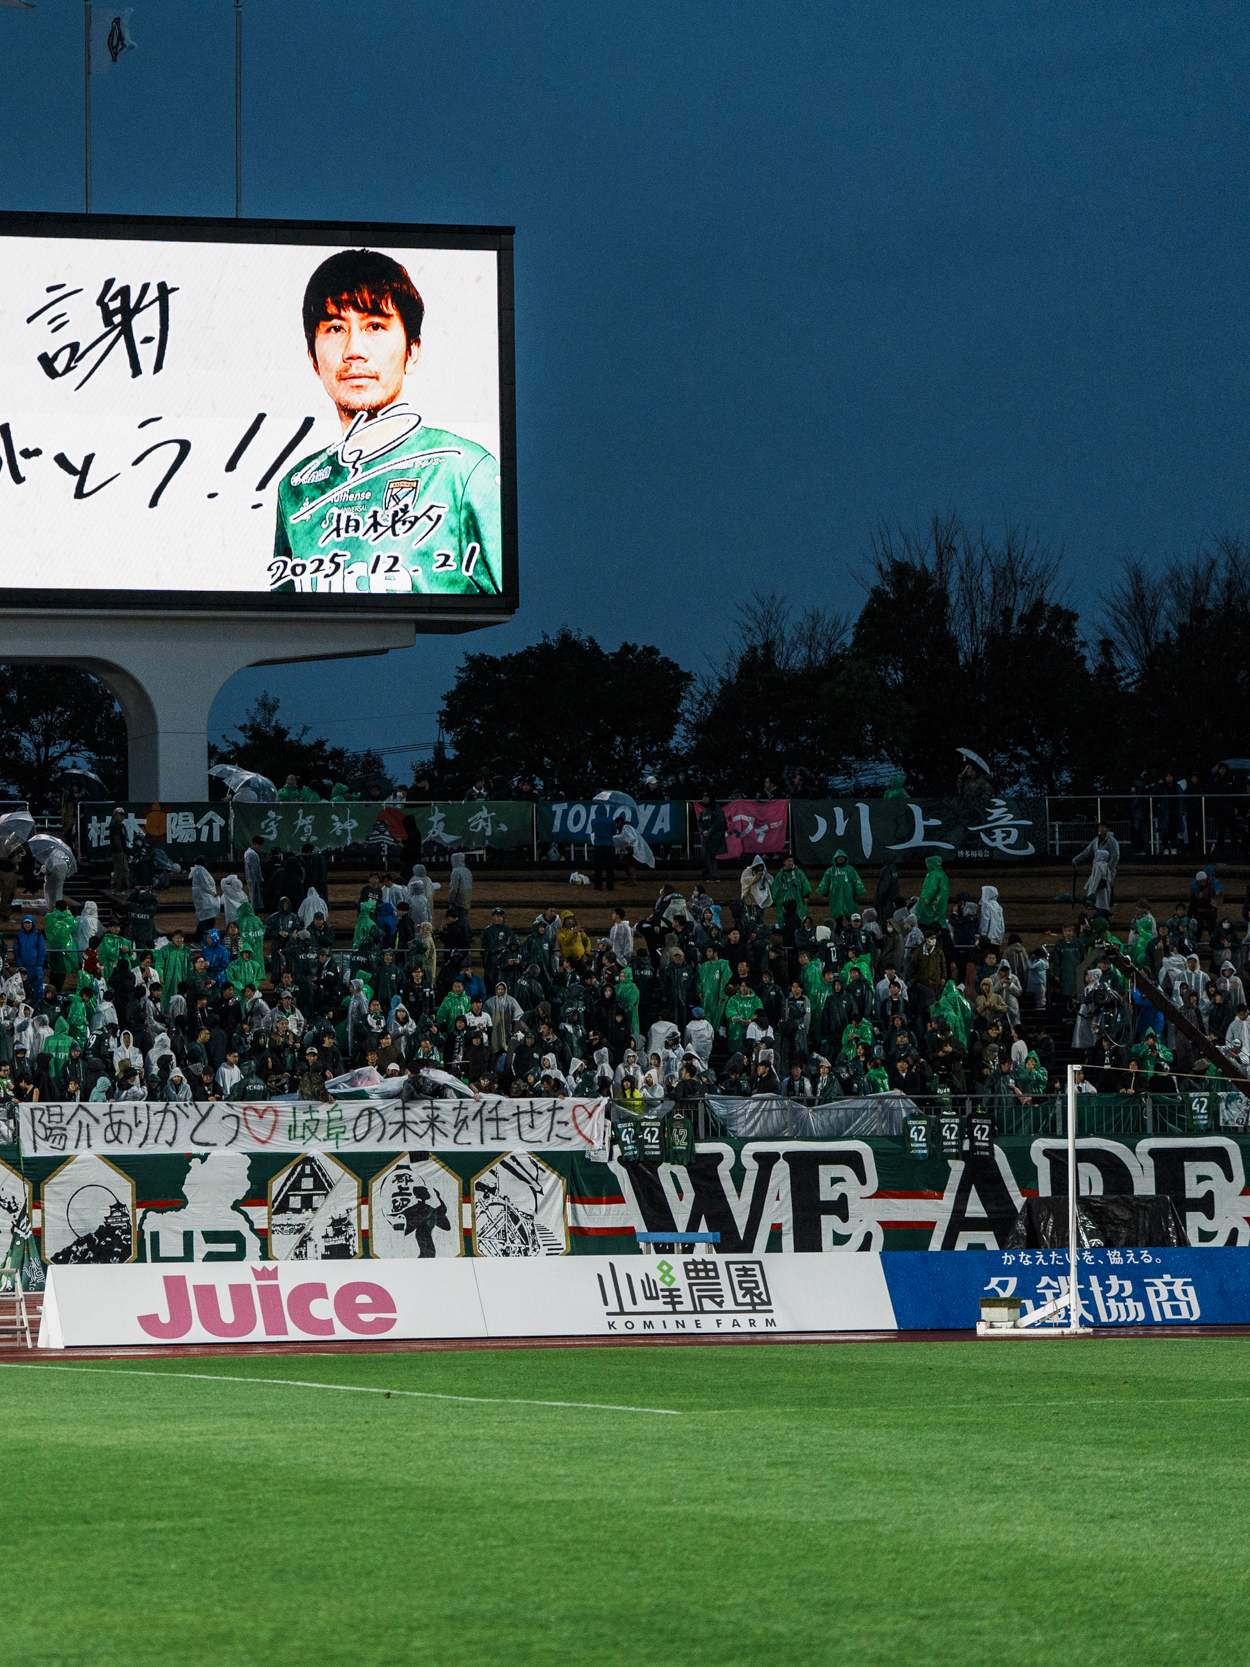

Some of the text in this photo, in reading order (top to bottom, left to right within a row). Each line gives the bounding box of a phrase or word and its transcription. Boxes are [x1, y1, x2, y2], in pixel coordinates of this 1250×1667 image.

[551, 802, 671, 835] TOOYA
[1191, 1097, 1208, 1114] 42
[621, 1127, 636, 1144] 42
[643, 1127, 660, 1143] 42
[671, 1129, 688, 1145] 42
[910, 1125, 926, 1142] 42
[942, 1124, 958, 1140] 42
[973, 1124, 990, 1141] 42
[137, 1265, 398, 1340] Juice
[607, 1317, 777, 1331] KOMINE FARM
